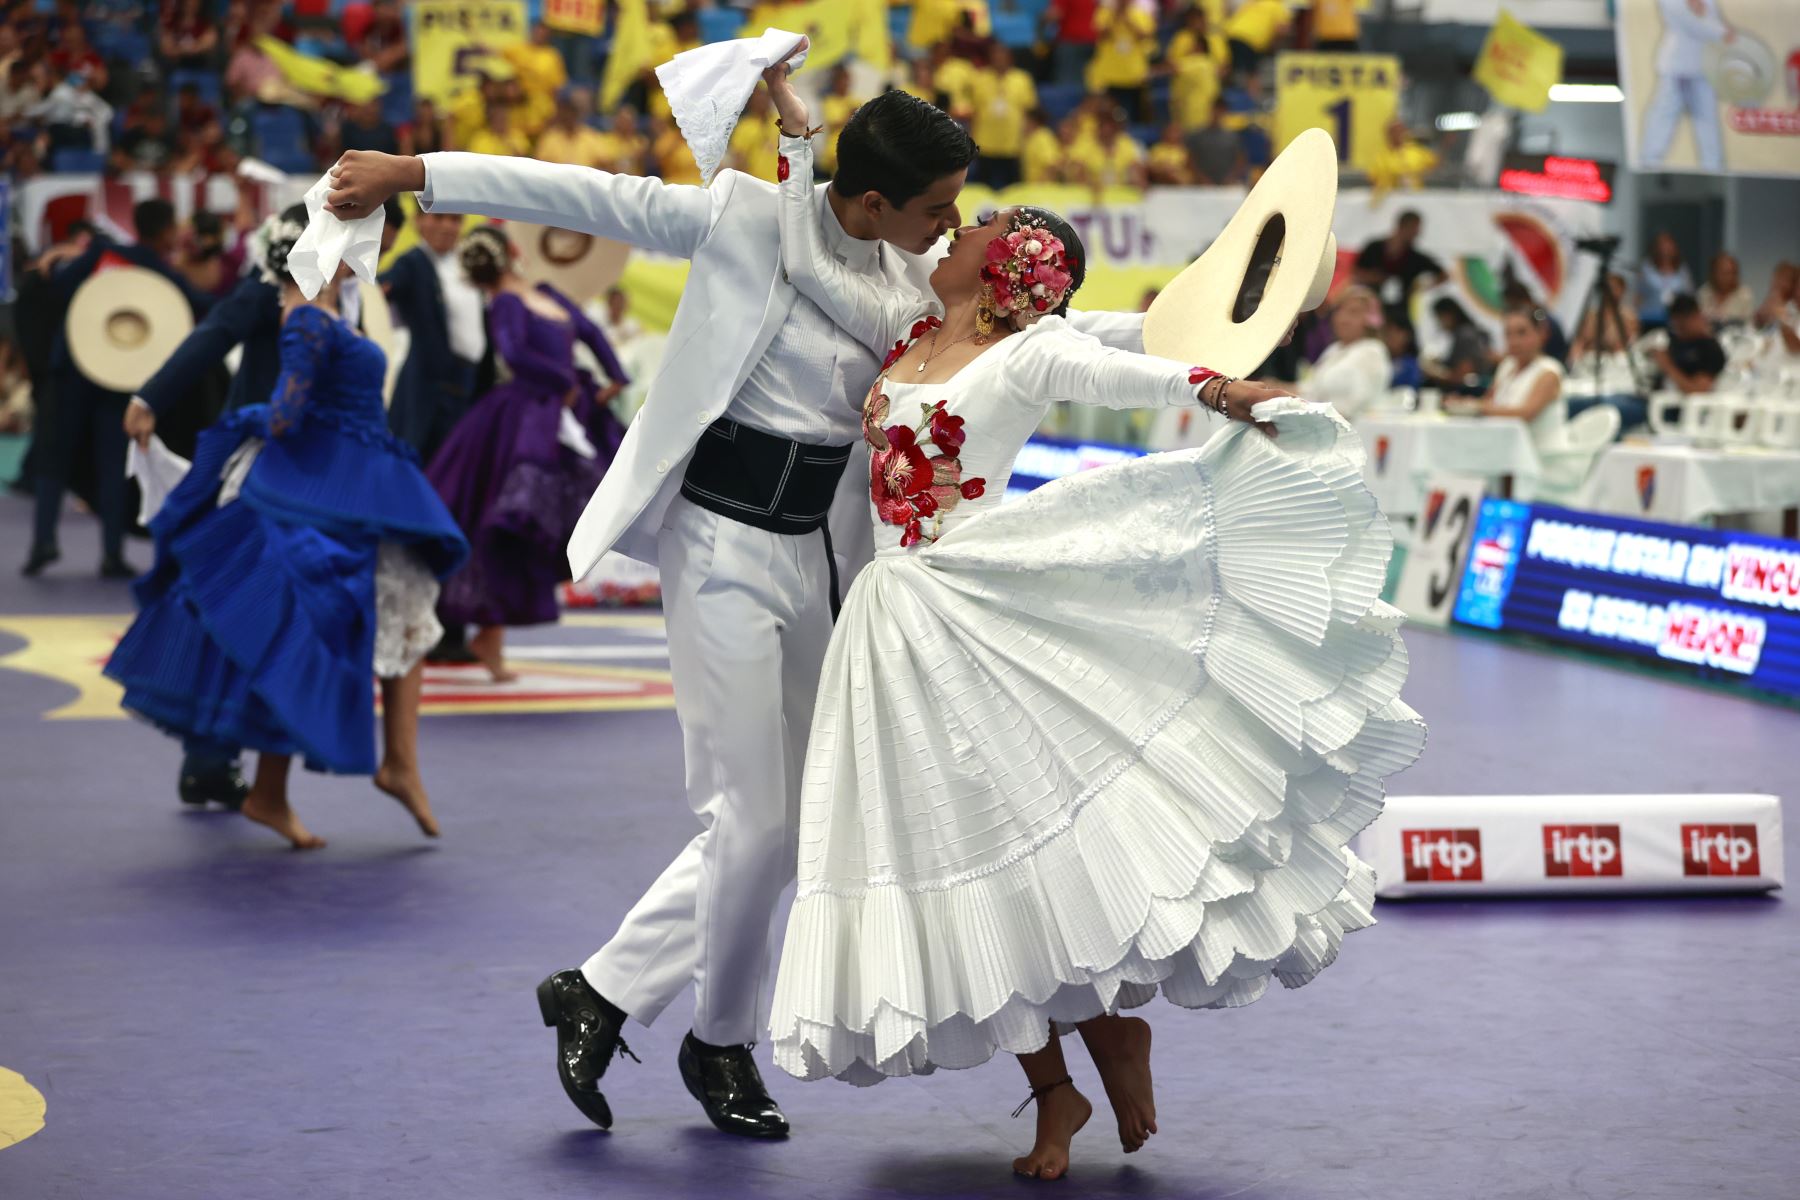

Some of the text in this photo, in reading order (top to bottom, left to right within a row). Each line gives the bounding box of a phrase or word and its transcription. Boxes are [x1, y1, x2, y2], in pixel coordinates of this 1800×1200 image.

[1284, 65, 1391, 89] PISTA
[1324, 98, 1353, 163] 1
[1411, 835, 1476, 877] irtp
[1552, 830, 1615, 873] irtp
[1690, 829, 1752, 872] irtp
